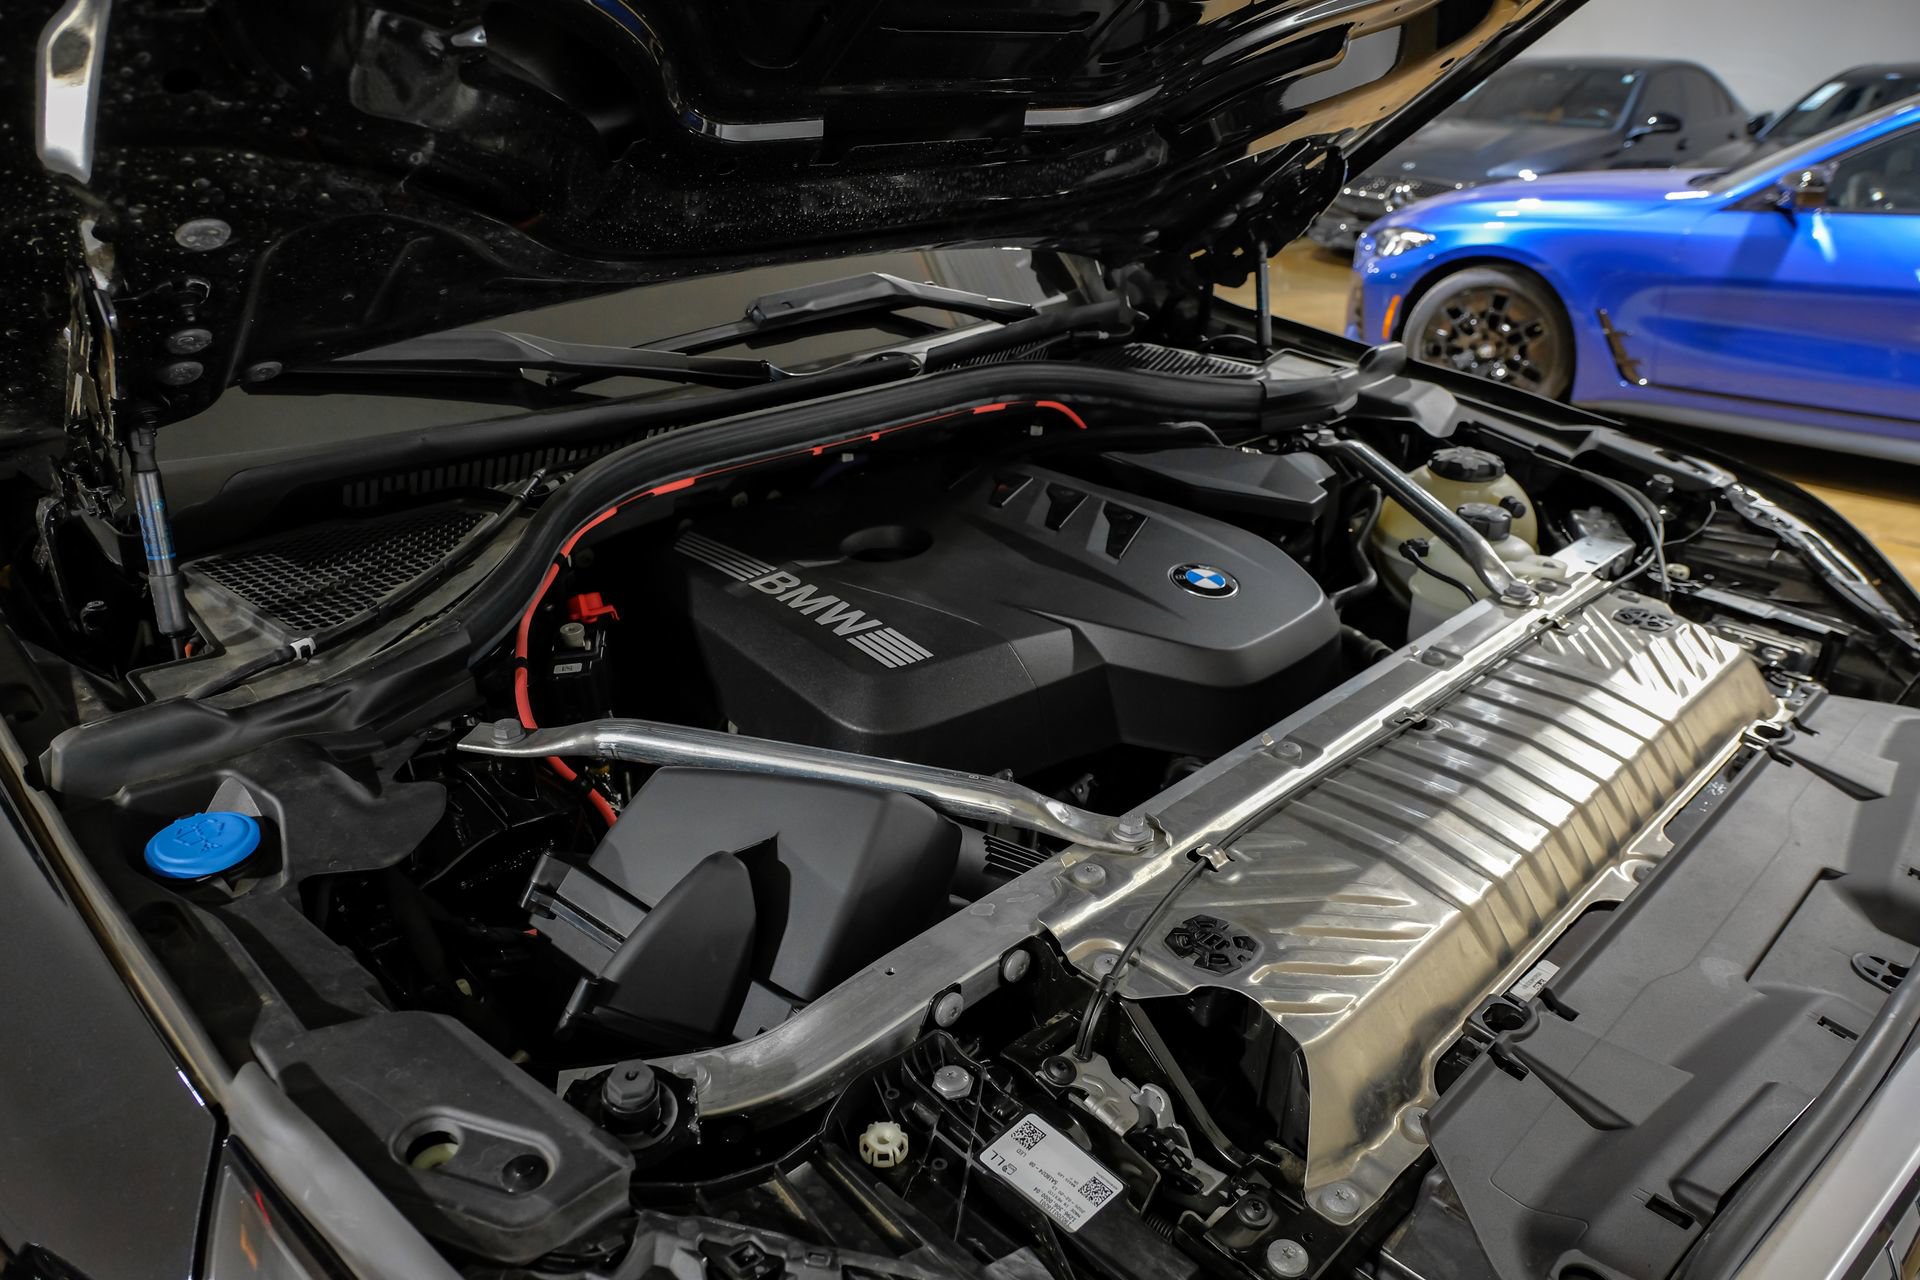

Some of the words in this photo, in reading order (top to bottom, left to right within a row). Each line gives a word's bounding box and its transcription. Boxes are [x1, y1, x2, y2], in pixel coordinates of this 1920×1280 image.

[748, 570, 884, 637] BMW
[990, 1149, 1006, 1166] LL
[1015, 1148, 1027, 1158] LED
[1047, 1190, 1063, 1202] MEXICO
